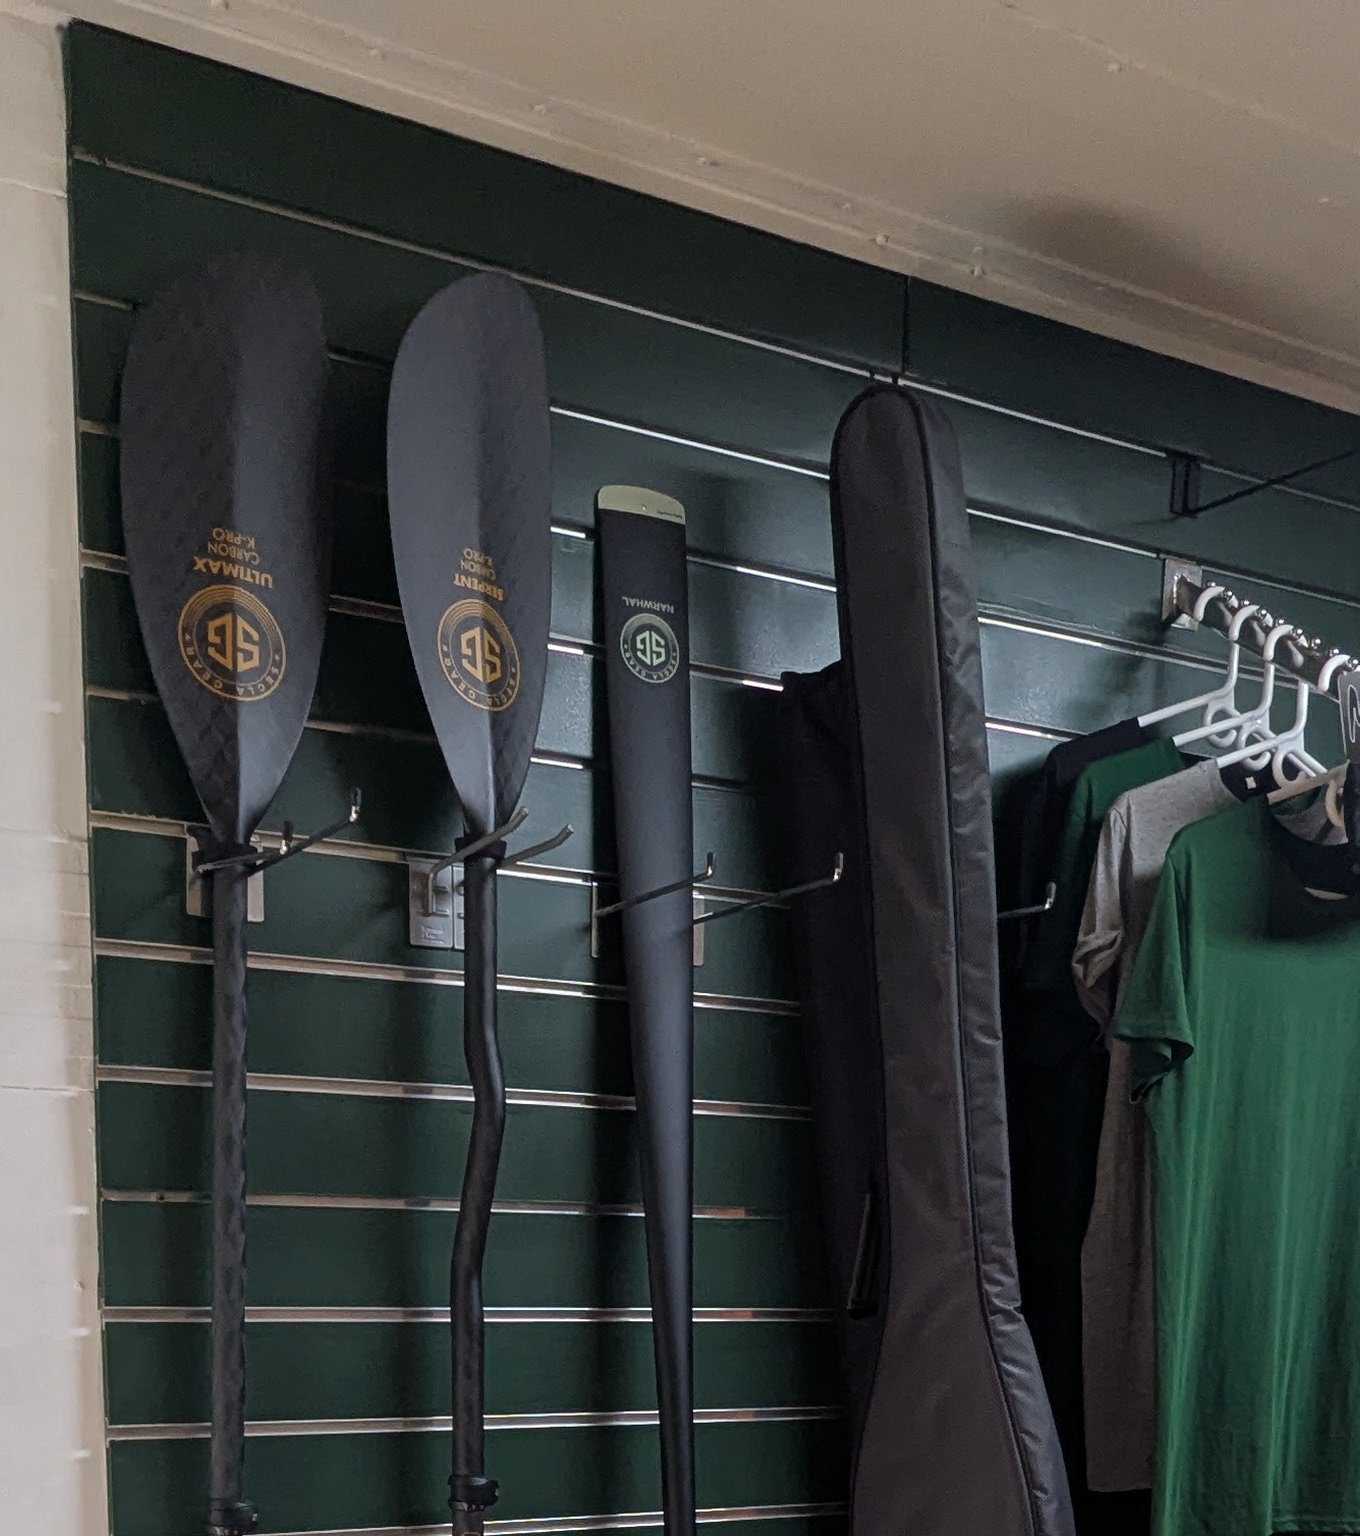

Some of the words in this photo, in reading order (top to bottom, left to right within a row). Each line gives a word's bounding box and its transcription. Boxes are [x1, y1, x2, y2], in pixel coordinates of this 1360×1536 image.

[207, 541, 260, 565] CARBON
[212, 527, 255, 549] K-PRO
[193, 556, 273, 588] ULTIMAX
[454, 573, 504, 601] SERPENT
[621, 596, 674, 614] NARWHAL
[207, 612, 260, 673] SG
[460, 626, 502, 683] SG
[636, 630, 665, 667] SG
